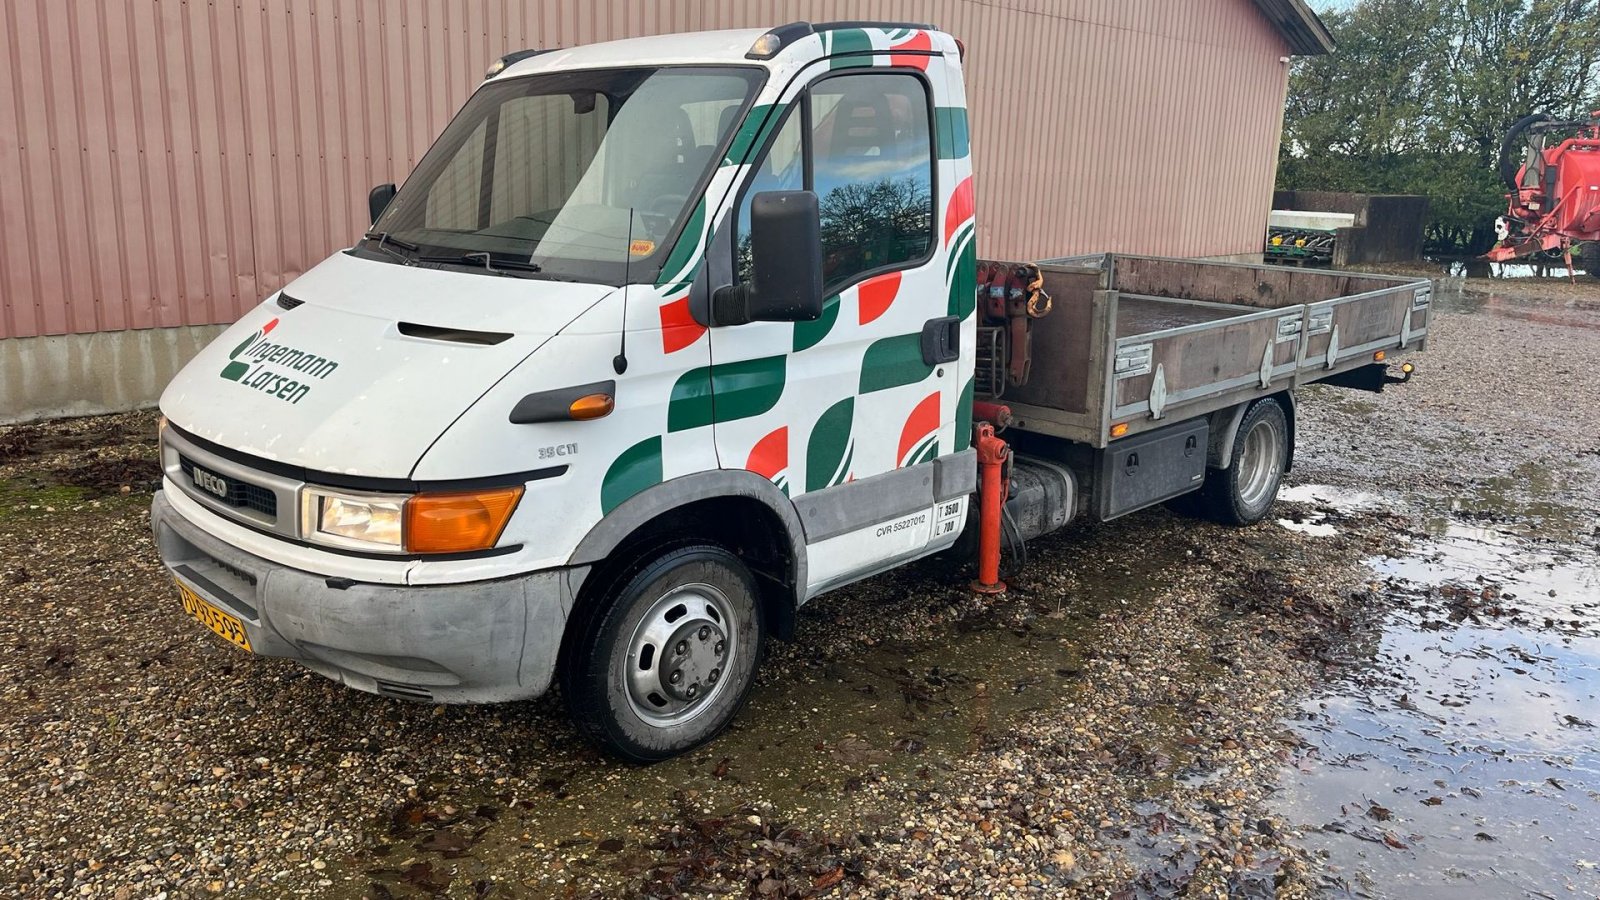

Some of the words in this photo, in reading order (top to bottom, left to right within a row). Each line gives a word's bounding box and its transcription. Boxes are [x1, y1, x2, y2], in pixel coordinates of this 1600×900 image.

[244, 338, 339, 379] Ingemann
[241, 365, 311, 404] Larsen
[193, 466, 227, 498] IVECO
[939, 506, 944, 518] T
[944, 502, 959, 517] 3500
[876, 524, 893, 537] CVR
[893, 514, 926, 533] 55227012
[943, 520, 955, 534] 700
